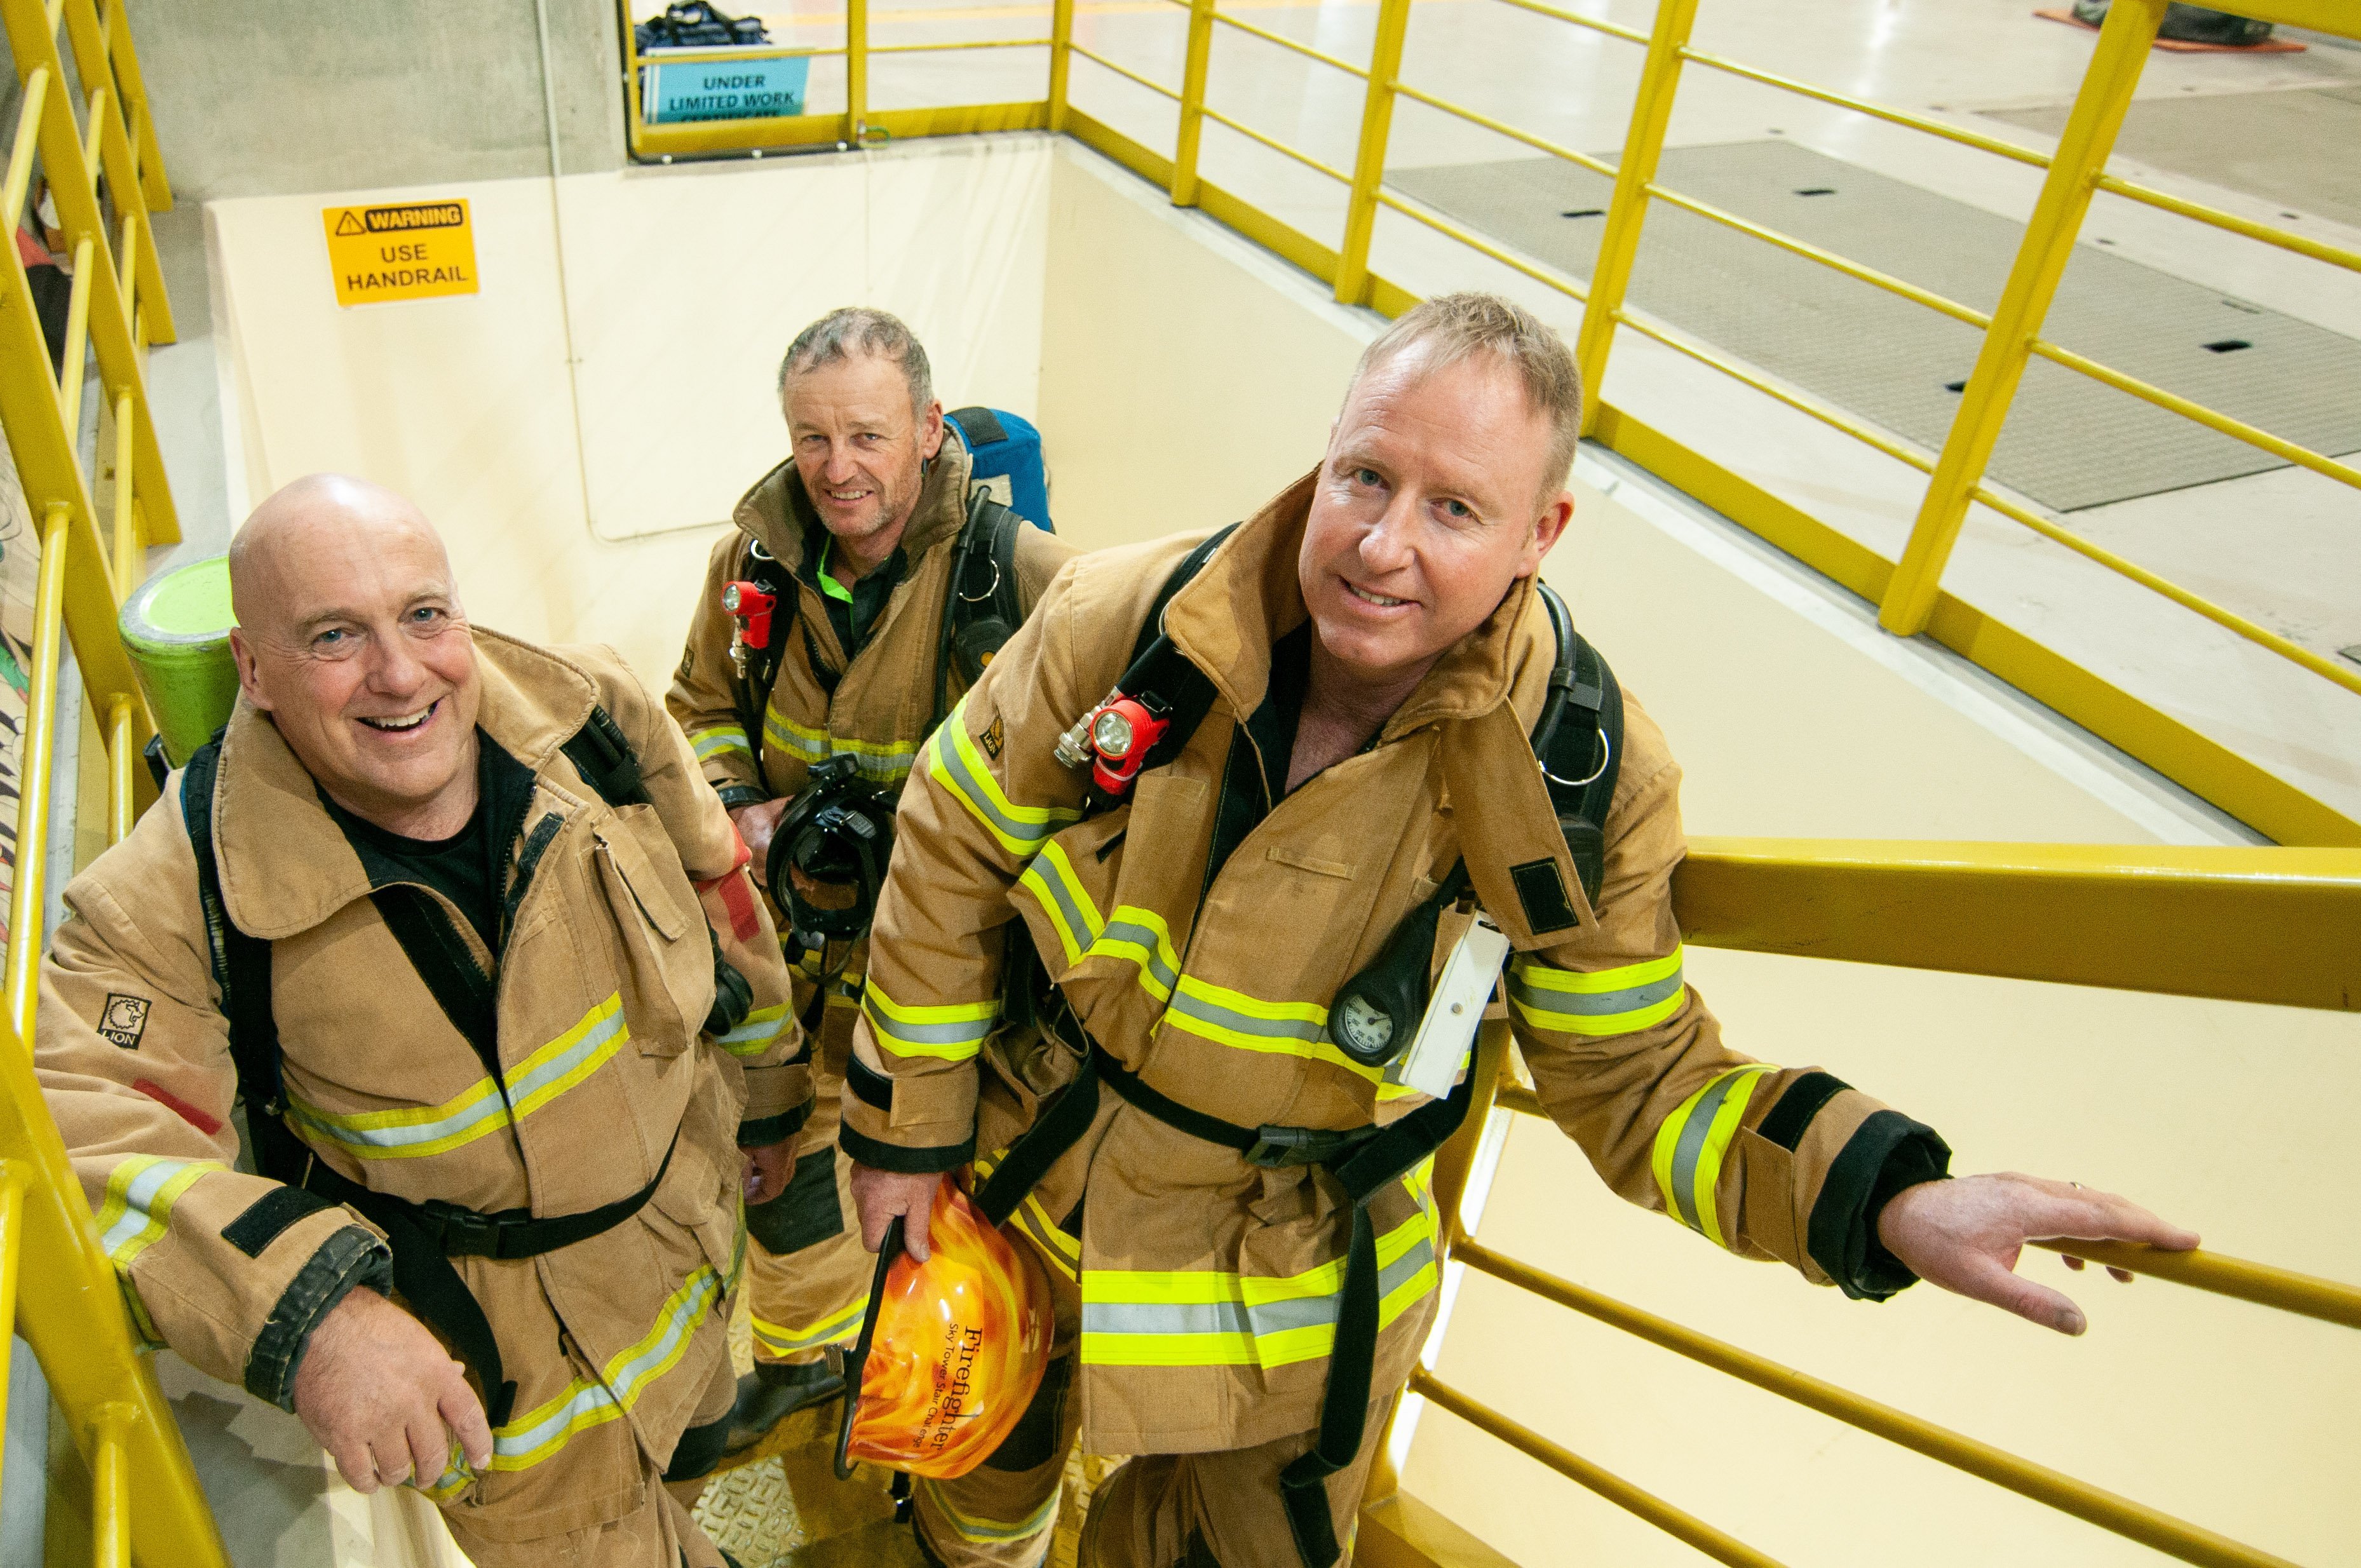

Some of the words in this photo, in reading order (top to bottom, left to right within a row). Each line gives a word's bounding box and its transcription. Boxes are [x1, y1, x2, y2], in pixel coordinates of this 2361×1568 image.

[703, 74, 766, 90] UNDER
[669, 94, 739, 111] LIMITED
[743, 91, 794, 107] WORK
[369, 206, 461, 229] WARNING
[381, 243, 428, 264] USE
[346, 266, 469, 291] HANDRAIL
[984, 733, 996, 754] LION
[945, 1323, 959, 1342] Sky
[940, 1346, 955, 1380] Tower
[930, 1325, 983, 1451] Firefighter
[932, 1382, 946, 1405] Stair
[912, 1407, 938, 1448] Chalenge
